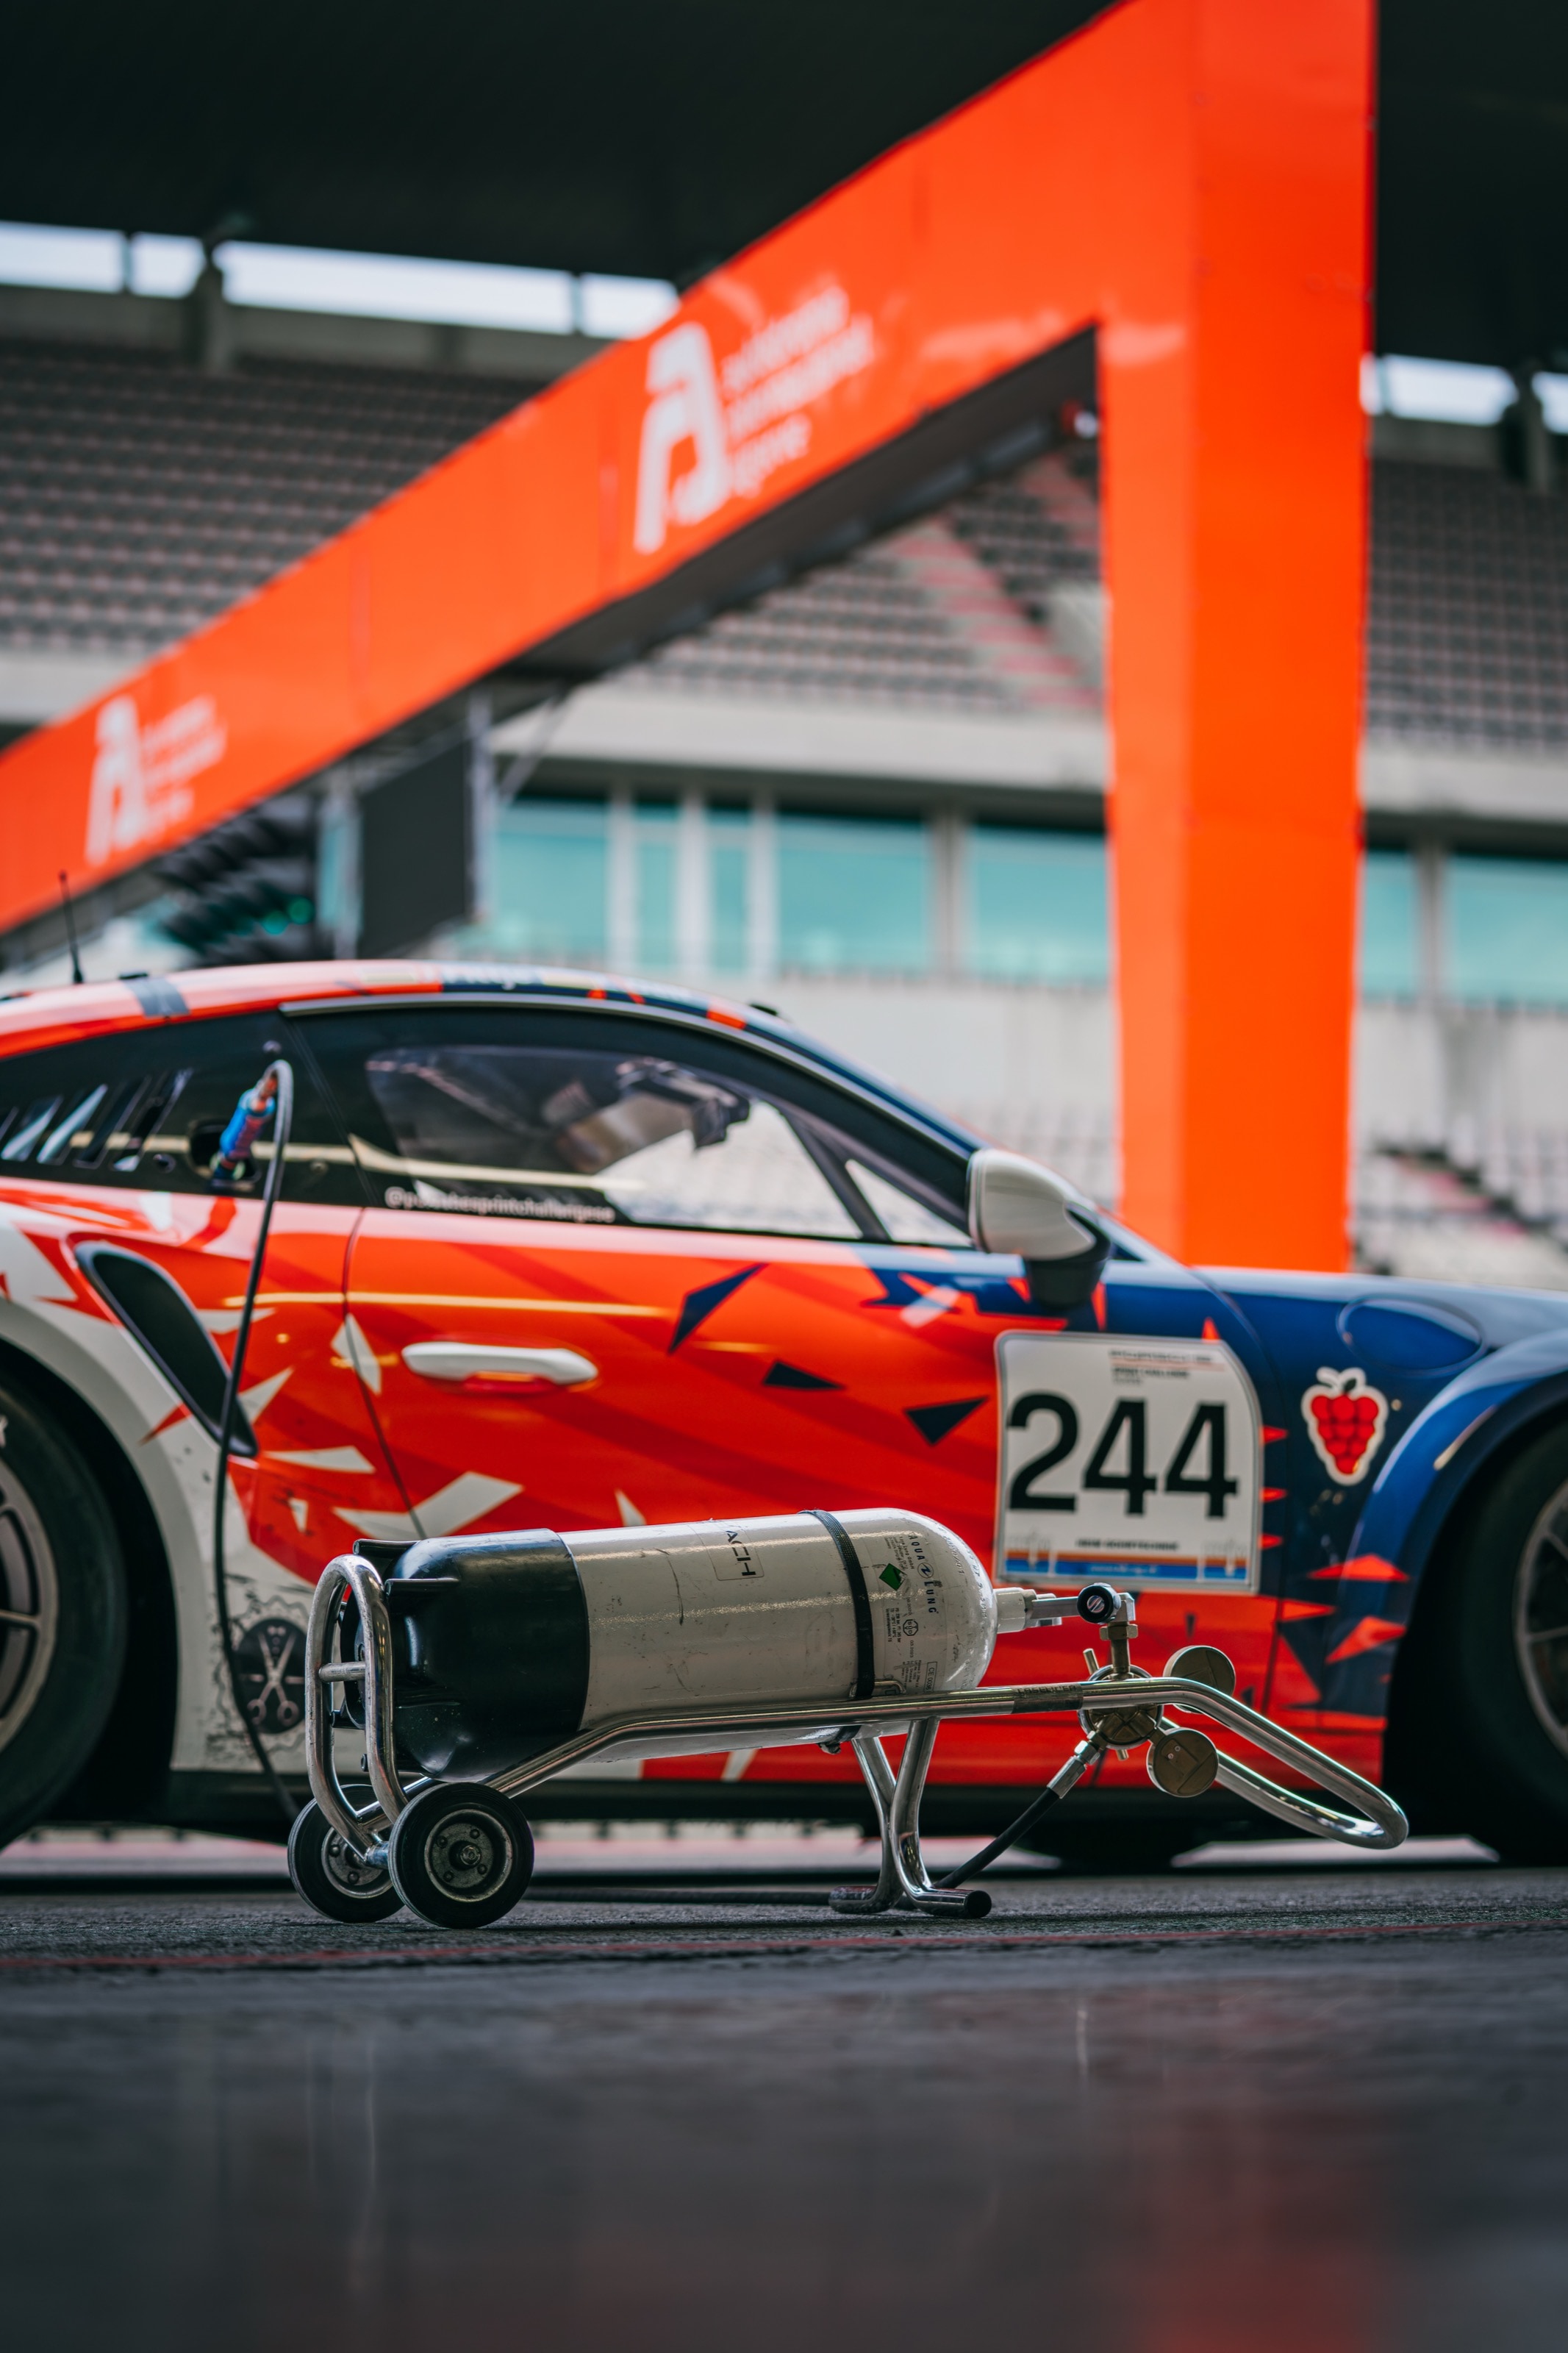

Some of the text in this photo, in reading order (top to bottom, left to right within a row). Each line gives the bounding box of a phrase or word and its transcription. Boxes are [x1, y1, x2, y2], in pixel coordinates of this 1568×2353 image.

[1006, 1390, 1239, 1520] 244
[908, 1535, 937, 1613] AQUA LUNG
[928, 1667, 935, 1676] CE
